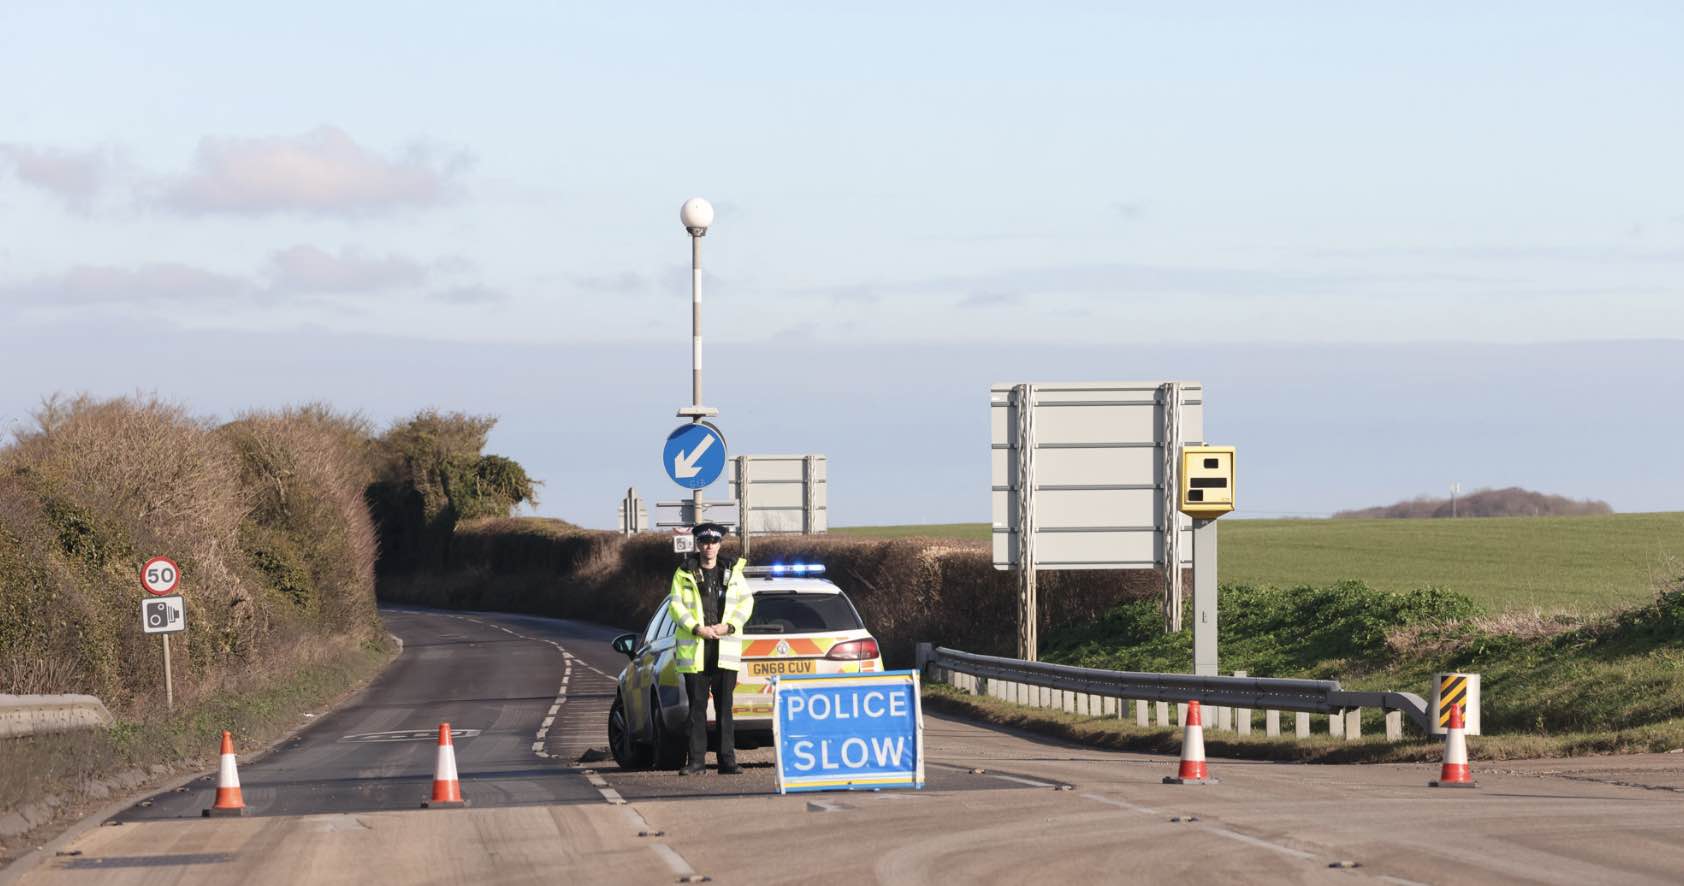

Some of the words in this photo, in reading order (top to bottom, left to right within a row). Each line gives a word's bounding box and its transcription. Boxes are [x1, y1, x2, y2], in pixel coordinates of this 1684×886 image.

[148, 568, 173, 583] 50
[753, 662, 785, 675] GN68
[788, 662, 811, 673] CUV
[787, 691, 907, 721] POLICE
[793, 736, 905, 771] SLOW
